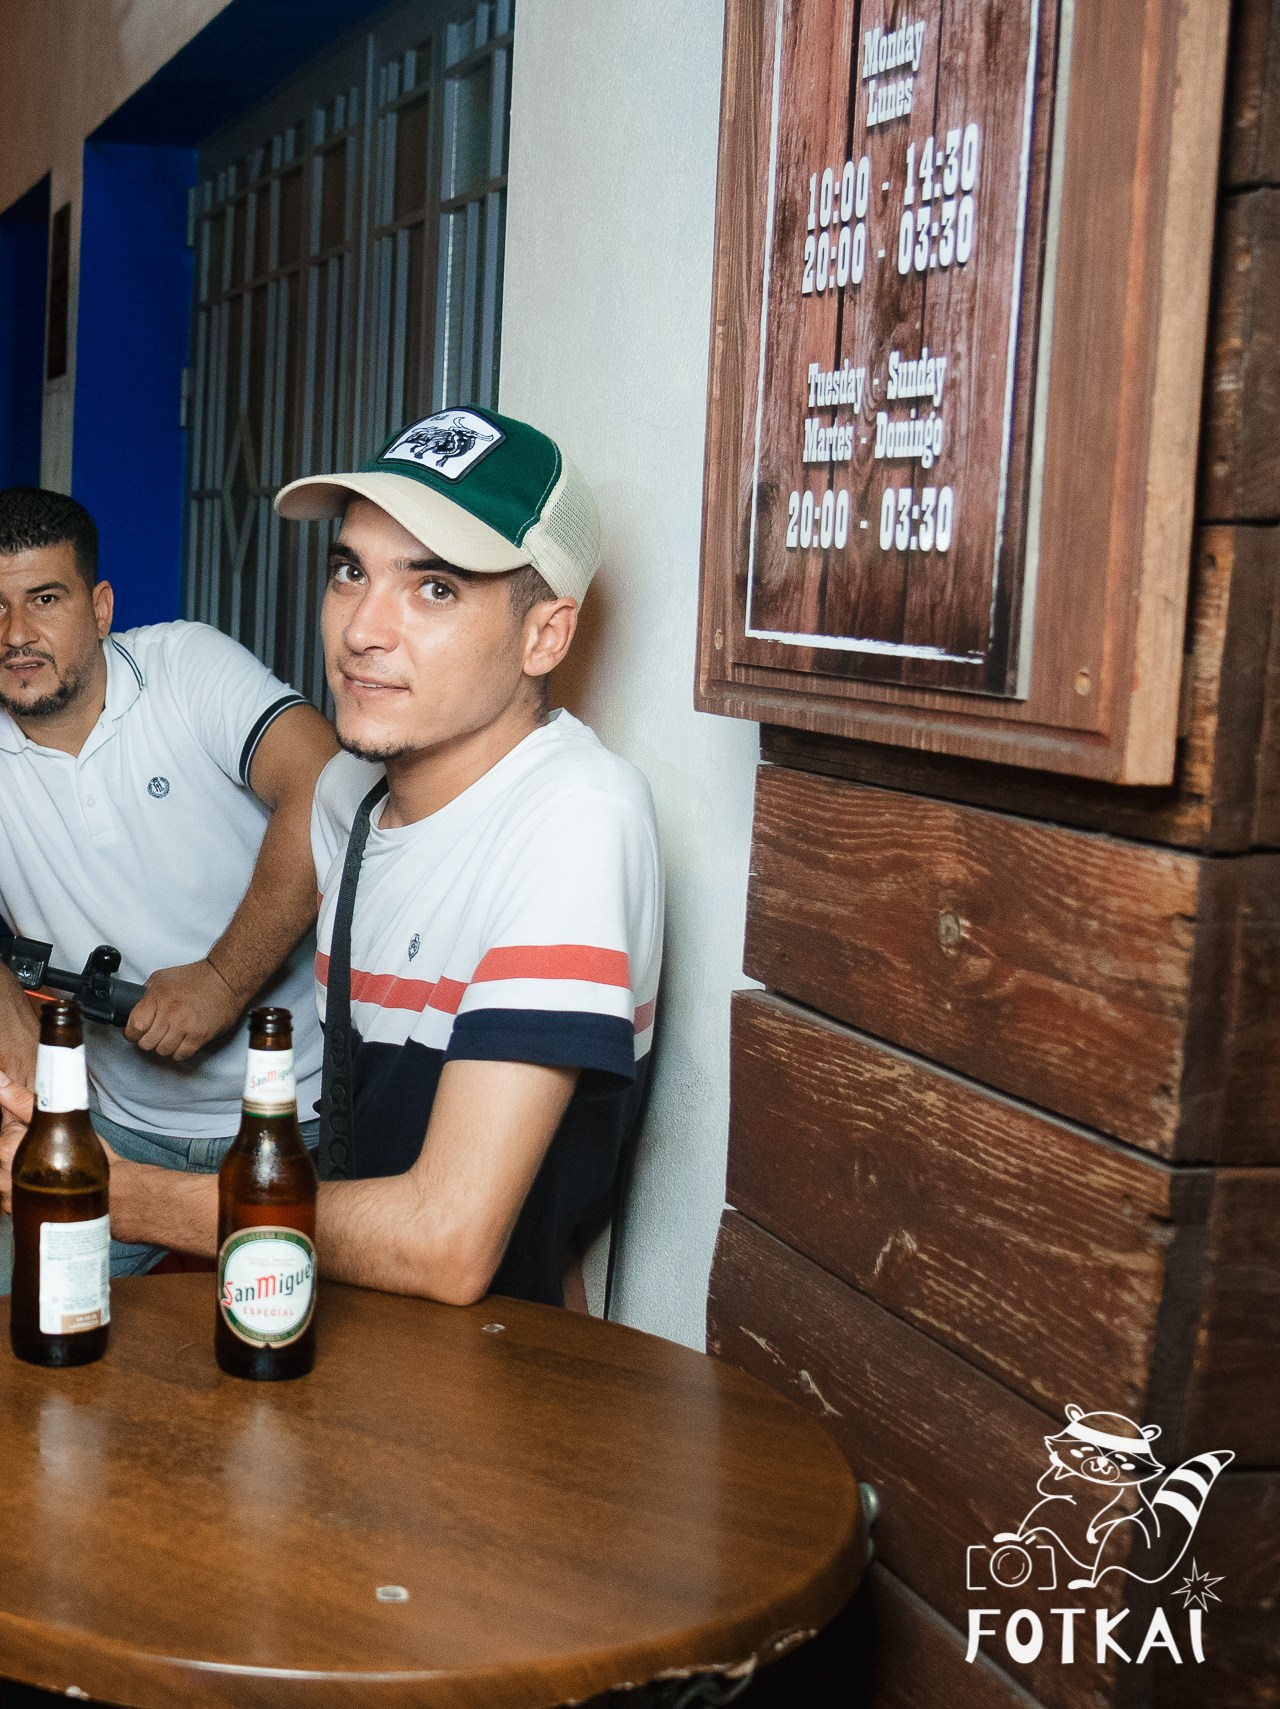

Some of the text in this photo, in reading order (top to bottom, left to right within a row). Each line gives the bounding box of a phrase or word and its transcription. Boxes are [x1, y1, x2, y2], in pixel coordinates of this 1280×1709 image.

[862, 16, 925, 79] Monday
[866, 77, 914, 127] Lunes
[807, 123, 978, 230] 10:00 - 14:30
[801, 195, 974, 294] 20:00 - 03:30
[808, 347, 947, 414] Tuesday - Sunday
[803, 417, 854, 462] Martes
[874, 408, 943, 469] Domingo
[786, 486, 953, 552] 20:00 - 03:30
[329, 1082, 352, 1180] GUC
[222, 1261, 313, 1307] SanMigue
[242, 1306, 294, 1318] ESPECIAL
